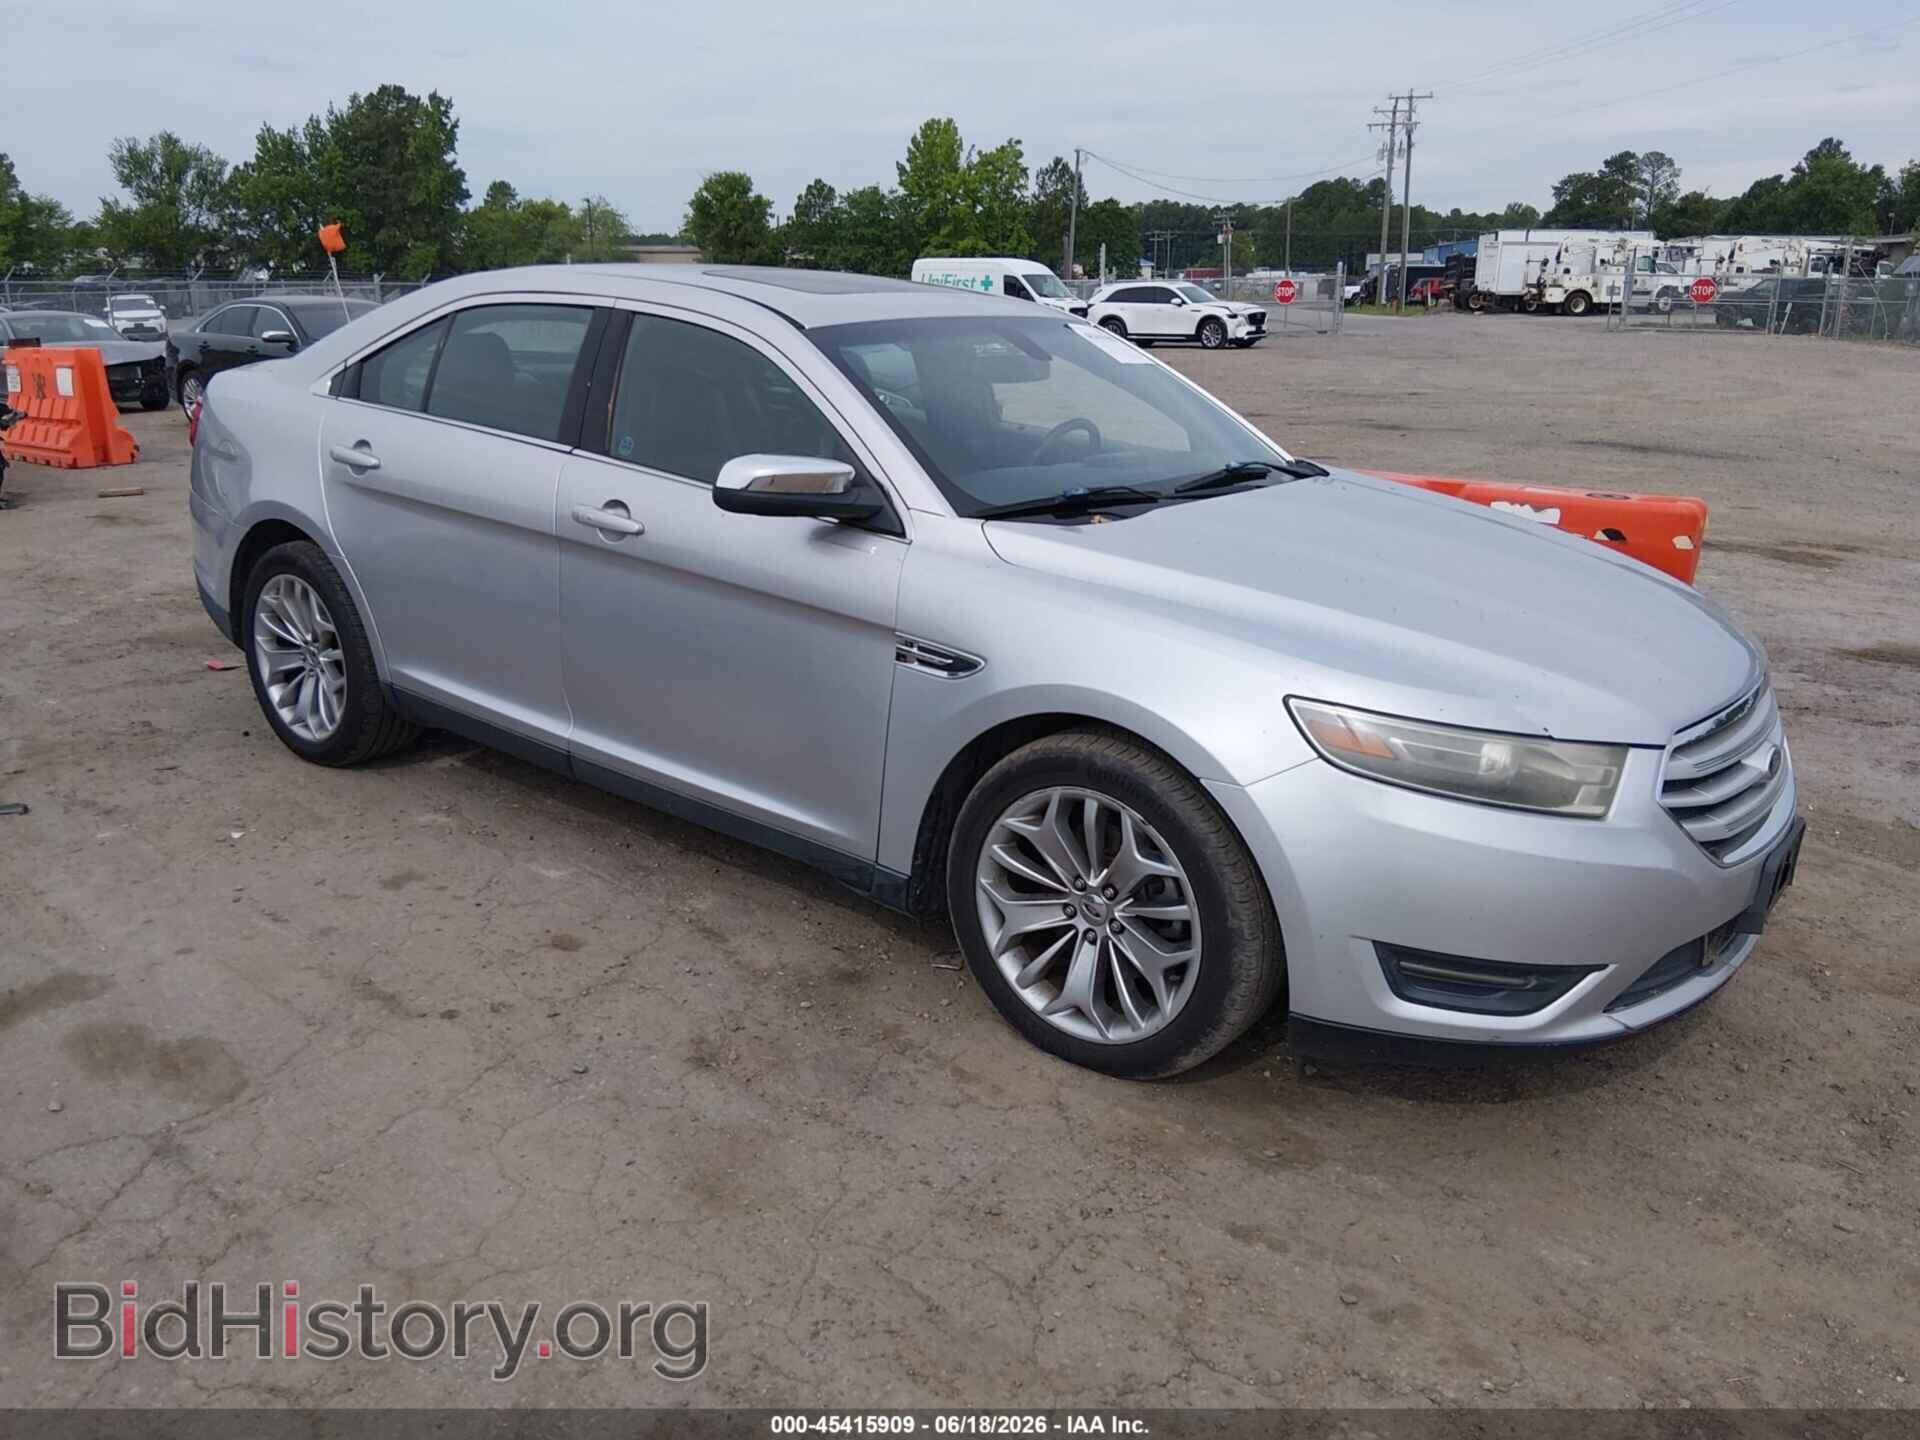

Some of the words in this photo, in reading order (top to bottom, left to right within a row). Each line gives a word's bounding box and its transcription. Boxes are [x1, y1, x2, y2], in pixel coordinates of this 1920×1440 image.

[921, 273, 976, 288] UniFirst
[1275, 286, 1295, 297] STOP
[1691, 286, 1714, 297] STOP
